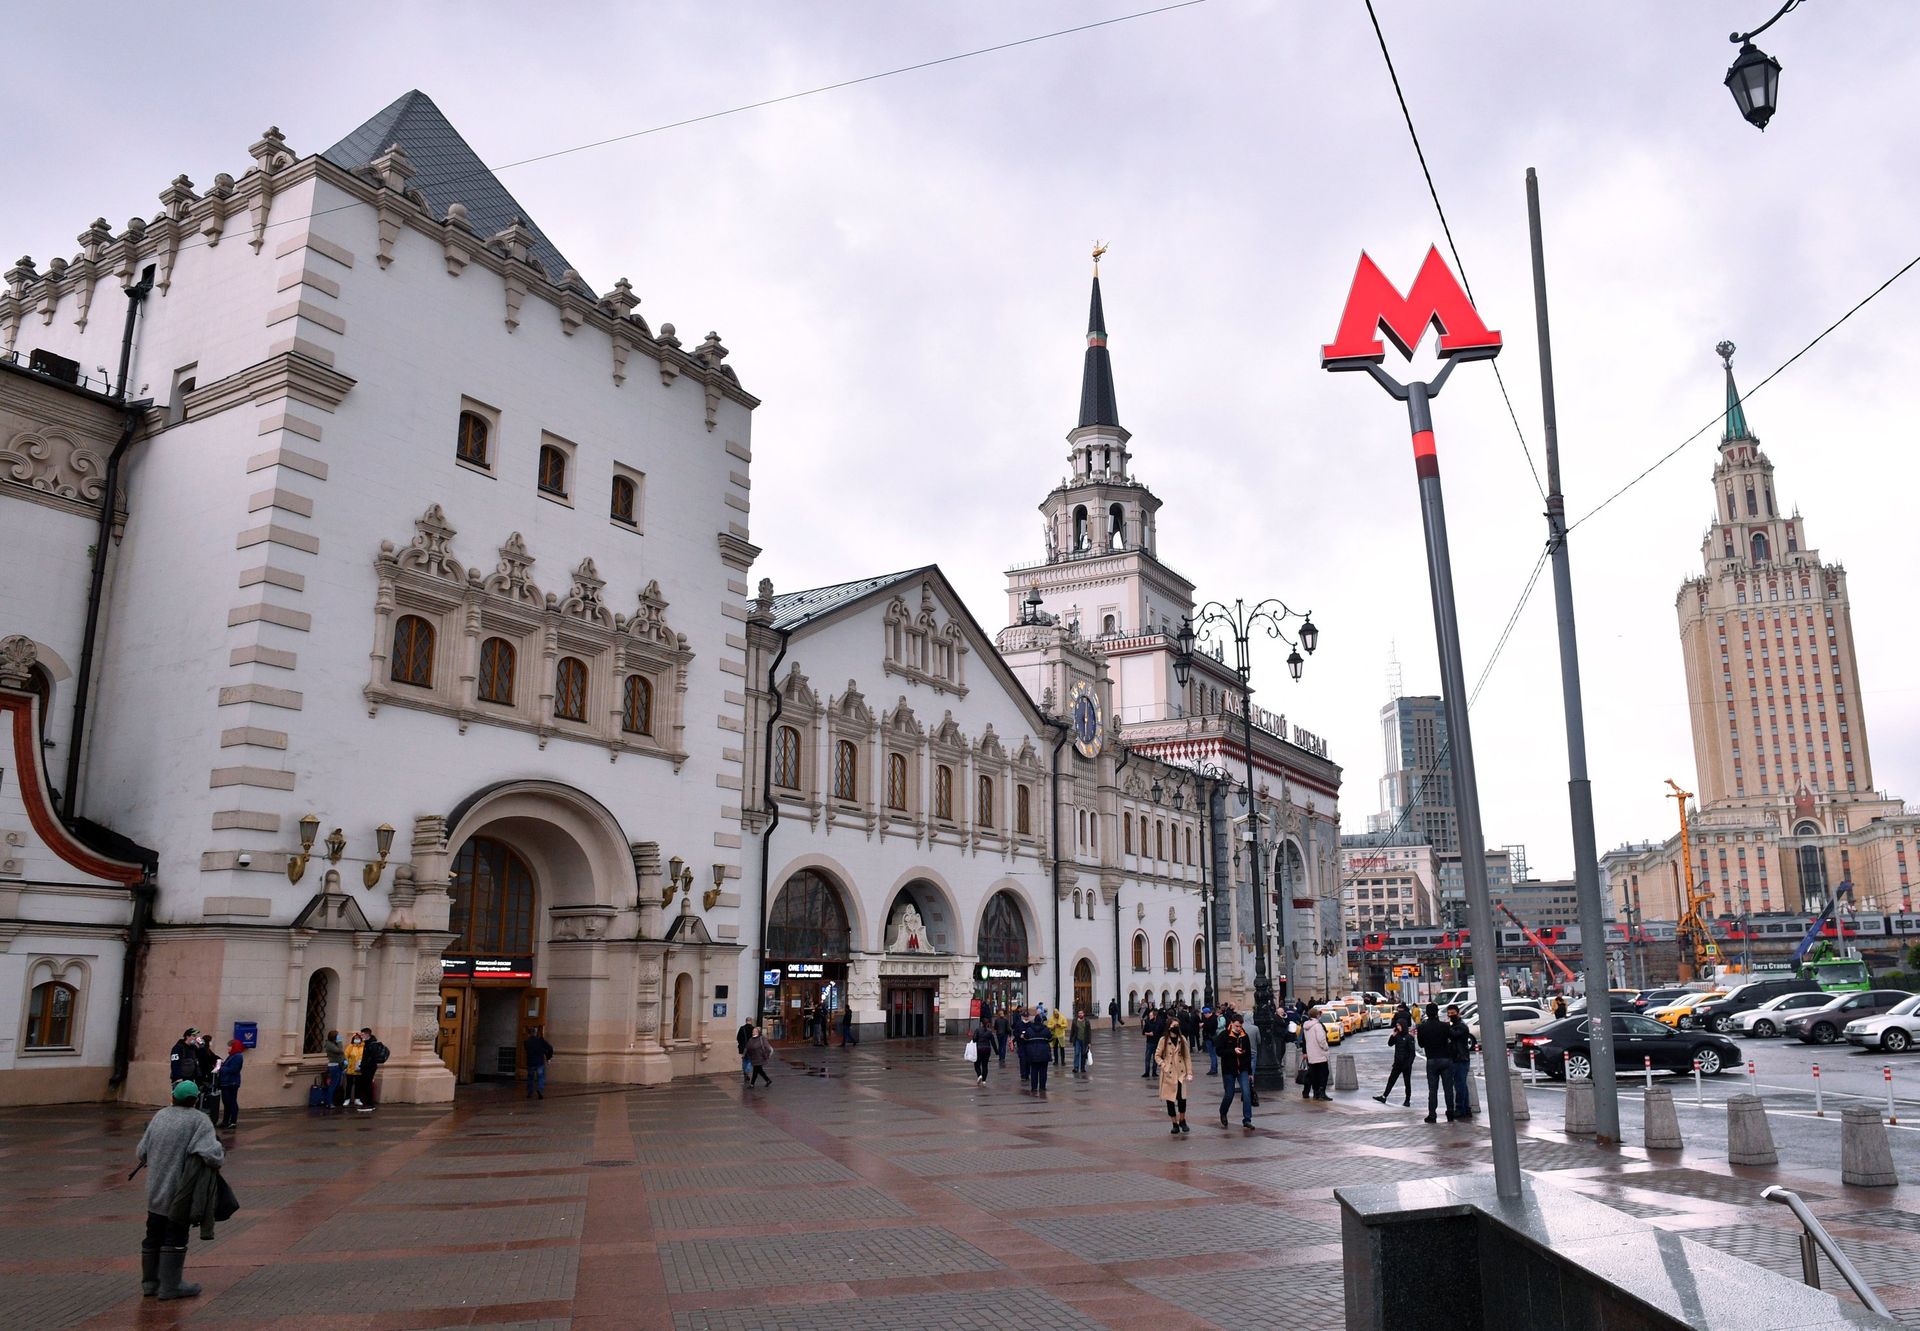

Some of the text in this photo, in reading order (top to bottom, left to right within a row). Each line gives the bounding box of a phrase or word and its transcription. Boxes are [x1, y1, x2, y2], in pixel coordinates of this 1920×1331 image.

[1224, 688, 1328, 758] КАНСКИЙ ВОКЗАЛ
[1769, 962, 1792, 970] Ставок
